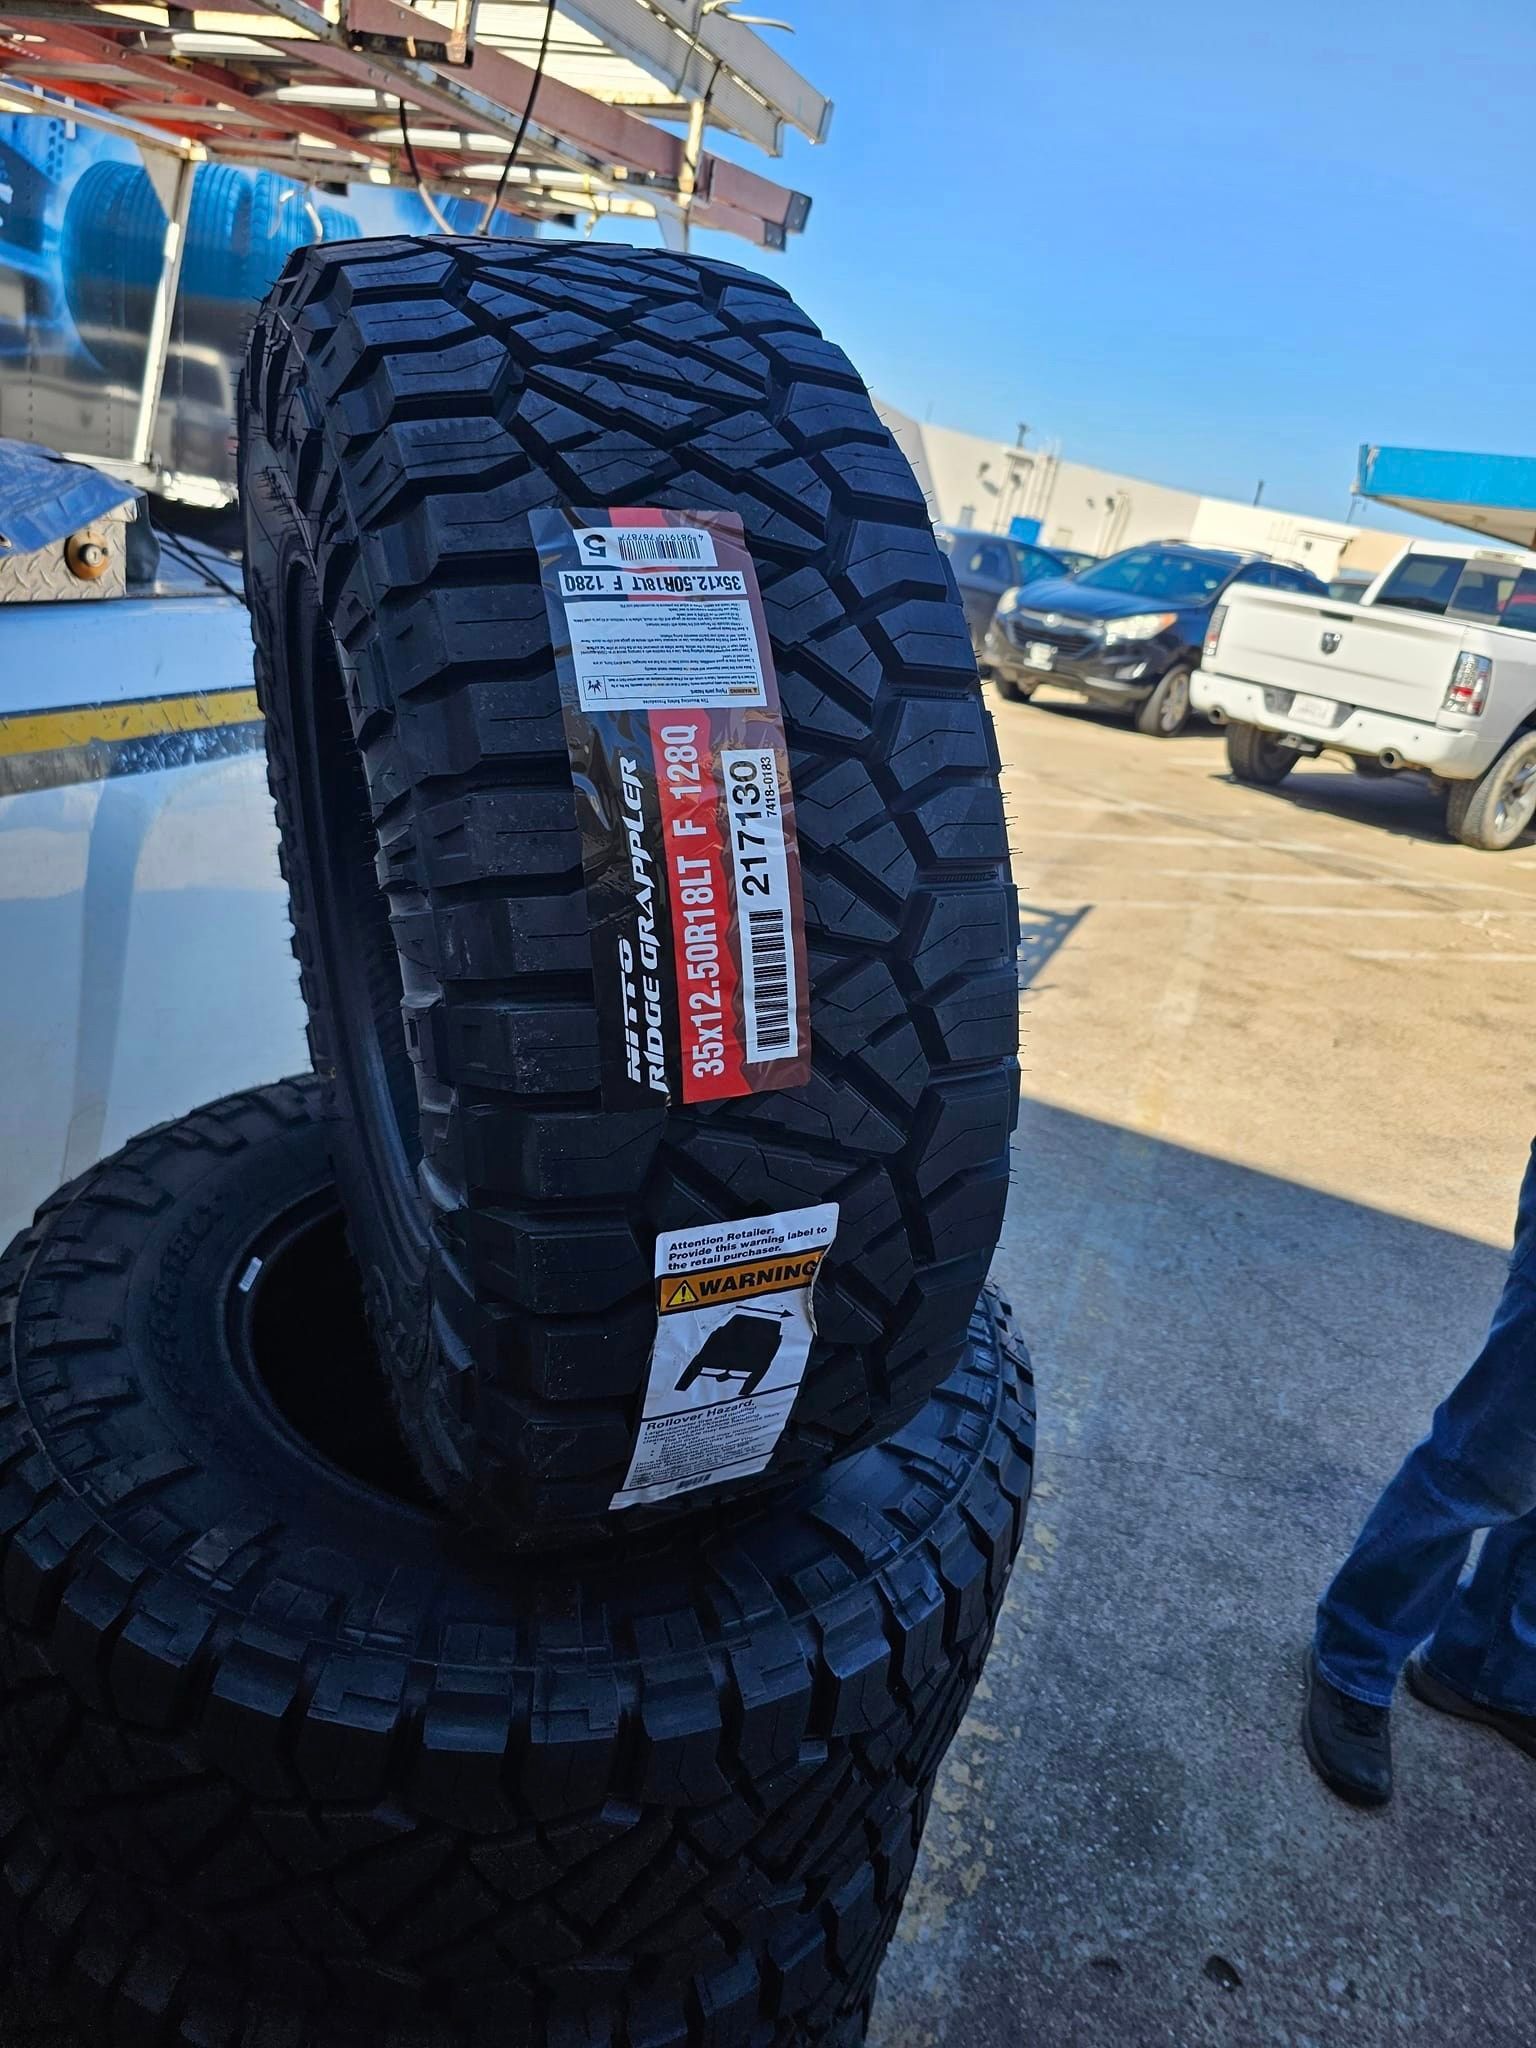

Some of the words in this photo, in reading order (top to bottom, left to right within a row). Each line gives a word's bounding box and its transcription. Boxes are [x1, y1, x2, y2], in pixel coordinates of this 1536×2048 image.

[583, 533, 607, 559] 5
[564, 573, 604, 592] 128Q
[614, 575, 623, 591] F
[632, 574, 742, 593] 35x12.50R18LT
[660, 724, 702, 800] 128Q
[760, 756, 778, 818] 7418-0183
[672, 819, 707, 838] F
[729, 760, 771, 897] 217130
[619, 756, 661, 970] GRAPPLER
[676, 856, 726, 1078] 35x12.50R18LT
[642, 975, 671, 1094] RIDGE
[668, 1245, 712, 1261] Provide
[715, 1241, 737, 1252] this
[740, 1235, 785, 1250] warning
[787, 1228, 813, 1241] label
[816, 1226, 828, 1235] to
[669, 1236, 723, 1251] Attention
[726, 1227, 775, 1242] Retailer:
[668, 1261, 687, 1271] the
[690, 1255, 721, 1267] retail
[723, 1245, 782, 1262] purchaser.
[699, 1260, 817, 1297] WARNING
[646, 1412, 704, 1430] Rollover
[706, 1399, 755, 1417] Hazard.
